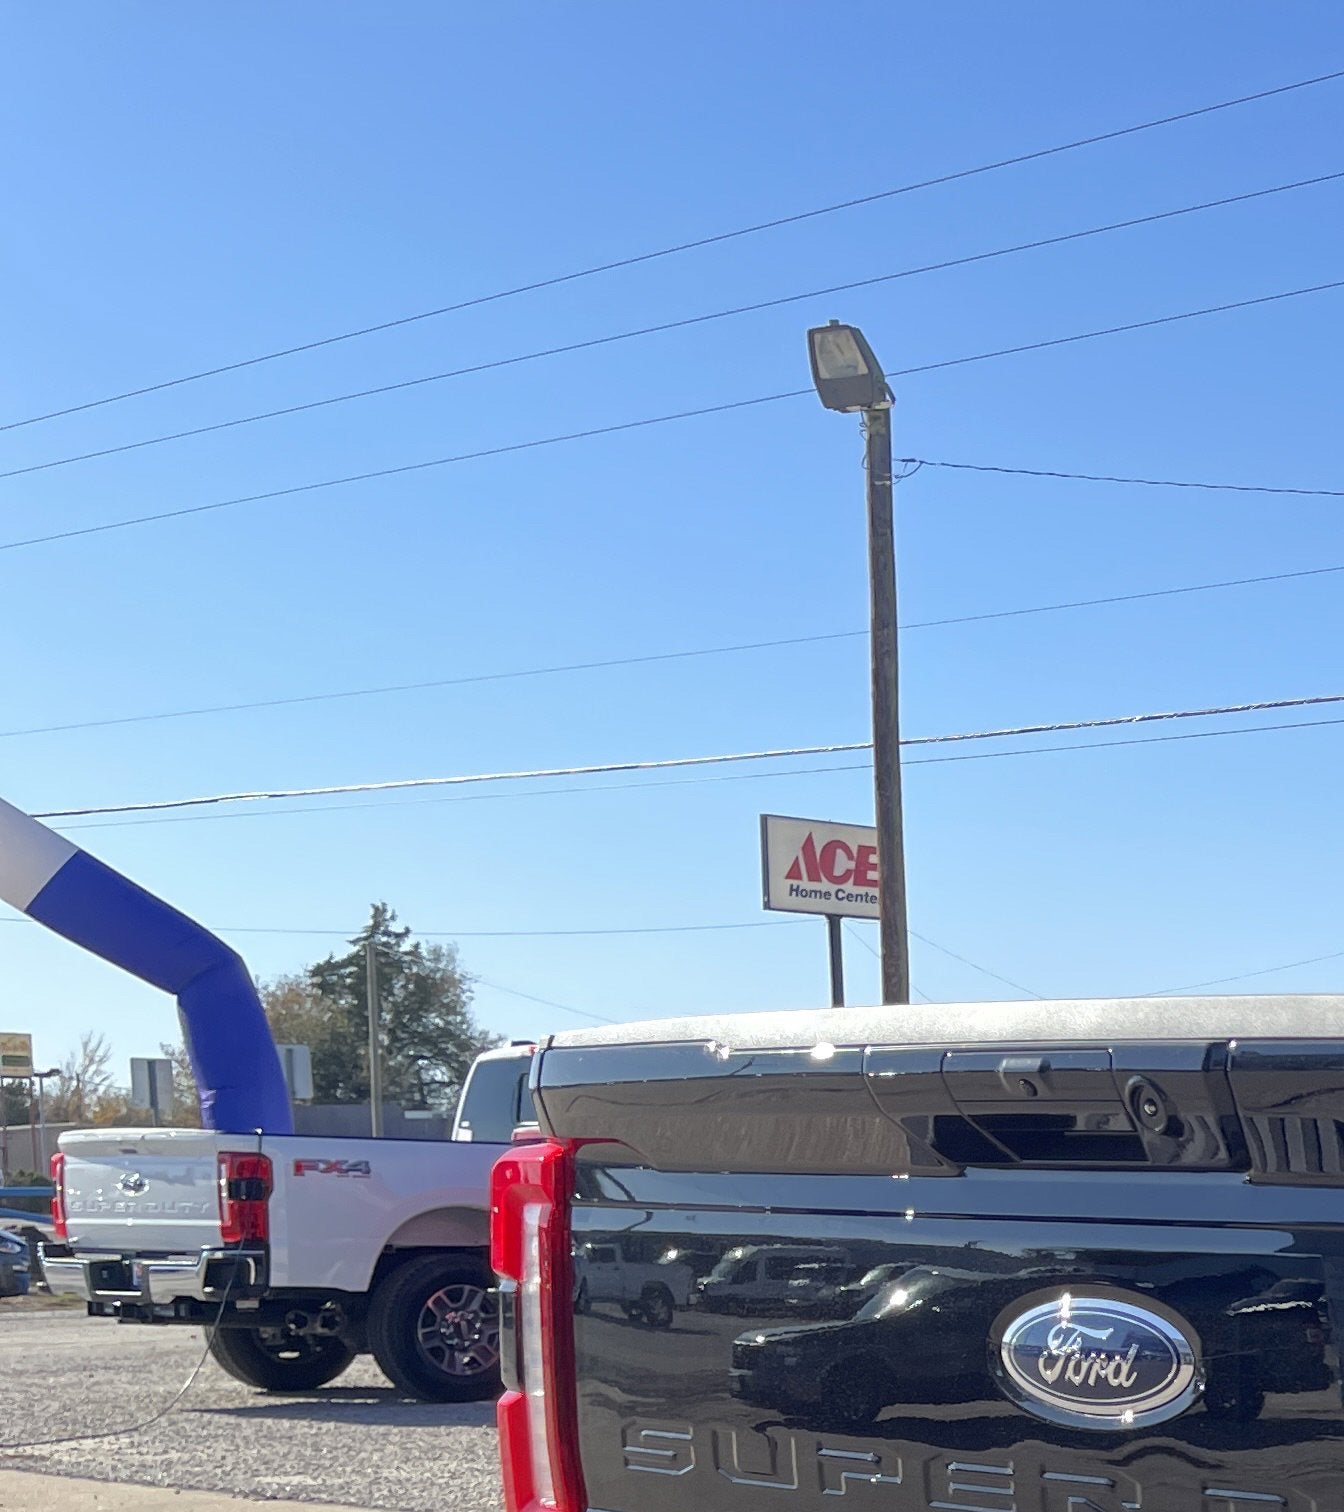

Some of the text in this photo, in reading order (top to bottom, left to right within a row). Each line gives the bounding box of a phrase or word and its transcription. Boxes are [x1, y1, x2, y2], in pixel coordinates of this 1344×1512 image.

[784, 831, 879, 888] ACE
[788, 884, 881, 905] Home Cente
[293, 1158, 372, 1177] FX4
[1037, 1321, 1142, 1388] Ford
